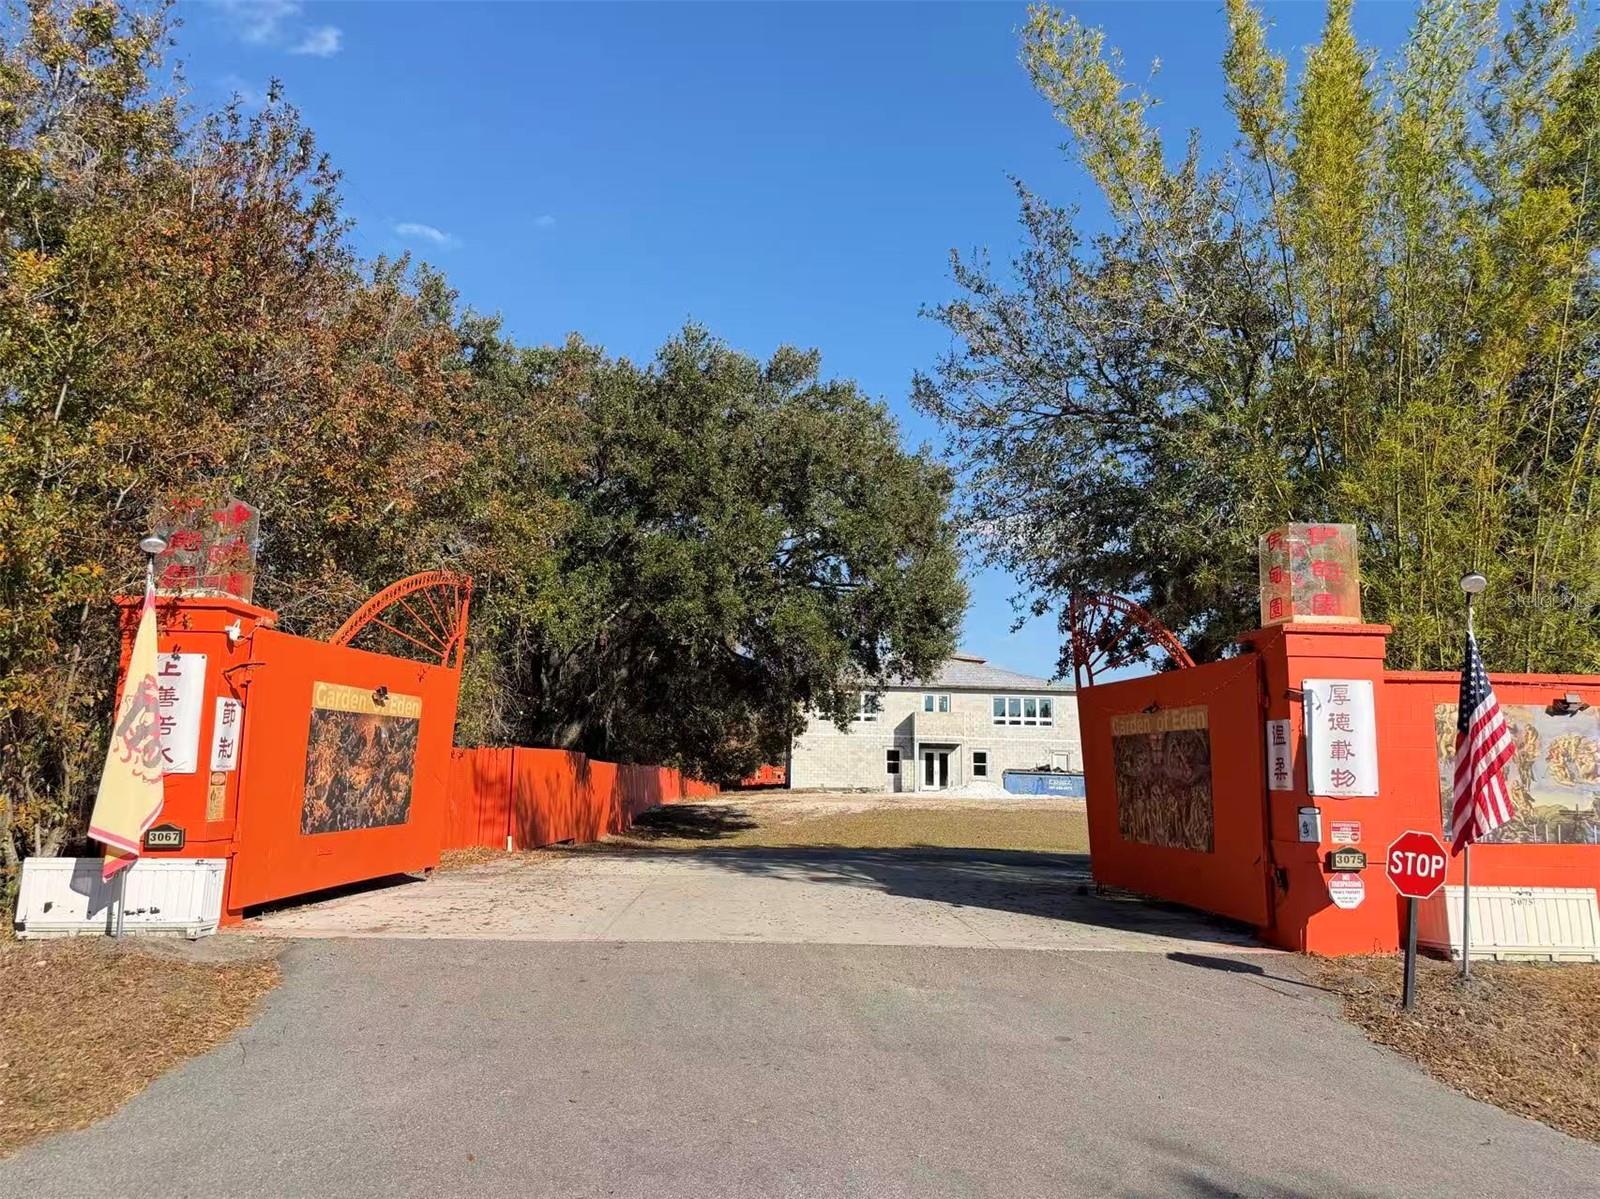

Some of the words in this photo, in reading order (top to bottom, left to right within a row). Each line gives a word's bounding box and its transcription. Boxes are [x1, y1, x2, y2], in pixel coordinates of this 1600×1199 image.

[316, 685, 367, 711] Garden
[391, 698, 419, 715] Eden
[218, 701, 236, 759] 節制
[1112, 716, 1150, 734] Garden
[1157, 711, 1169, 731] of
[1172, 709, 1207, 728] Eden
[1328, 684, 1357, 788] 厚德載物
[150, 833, 179, 842] 3067
[1337, 855, 1363, 864] 3075
[1390, 850, 1444, 878] STOP
